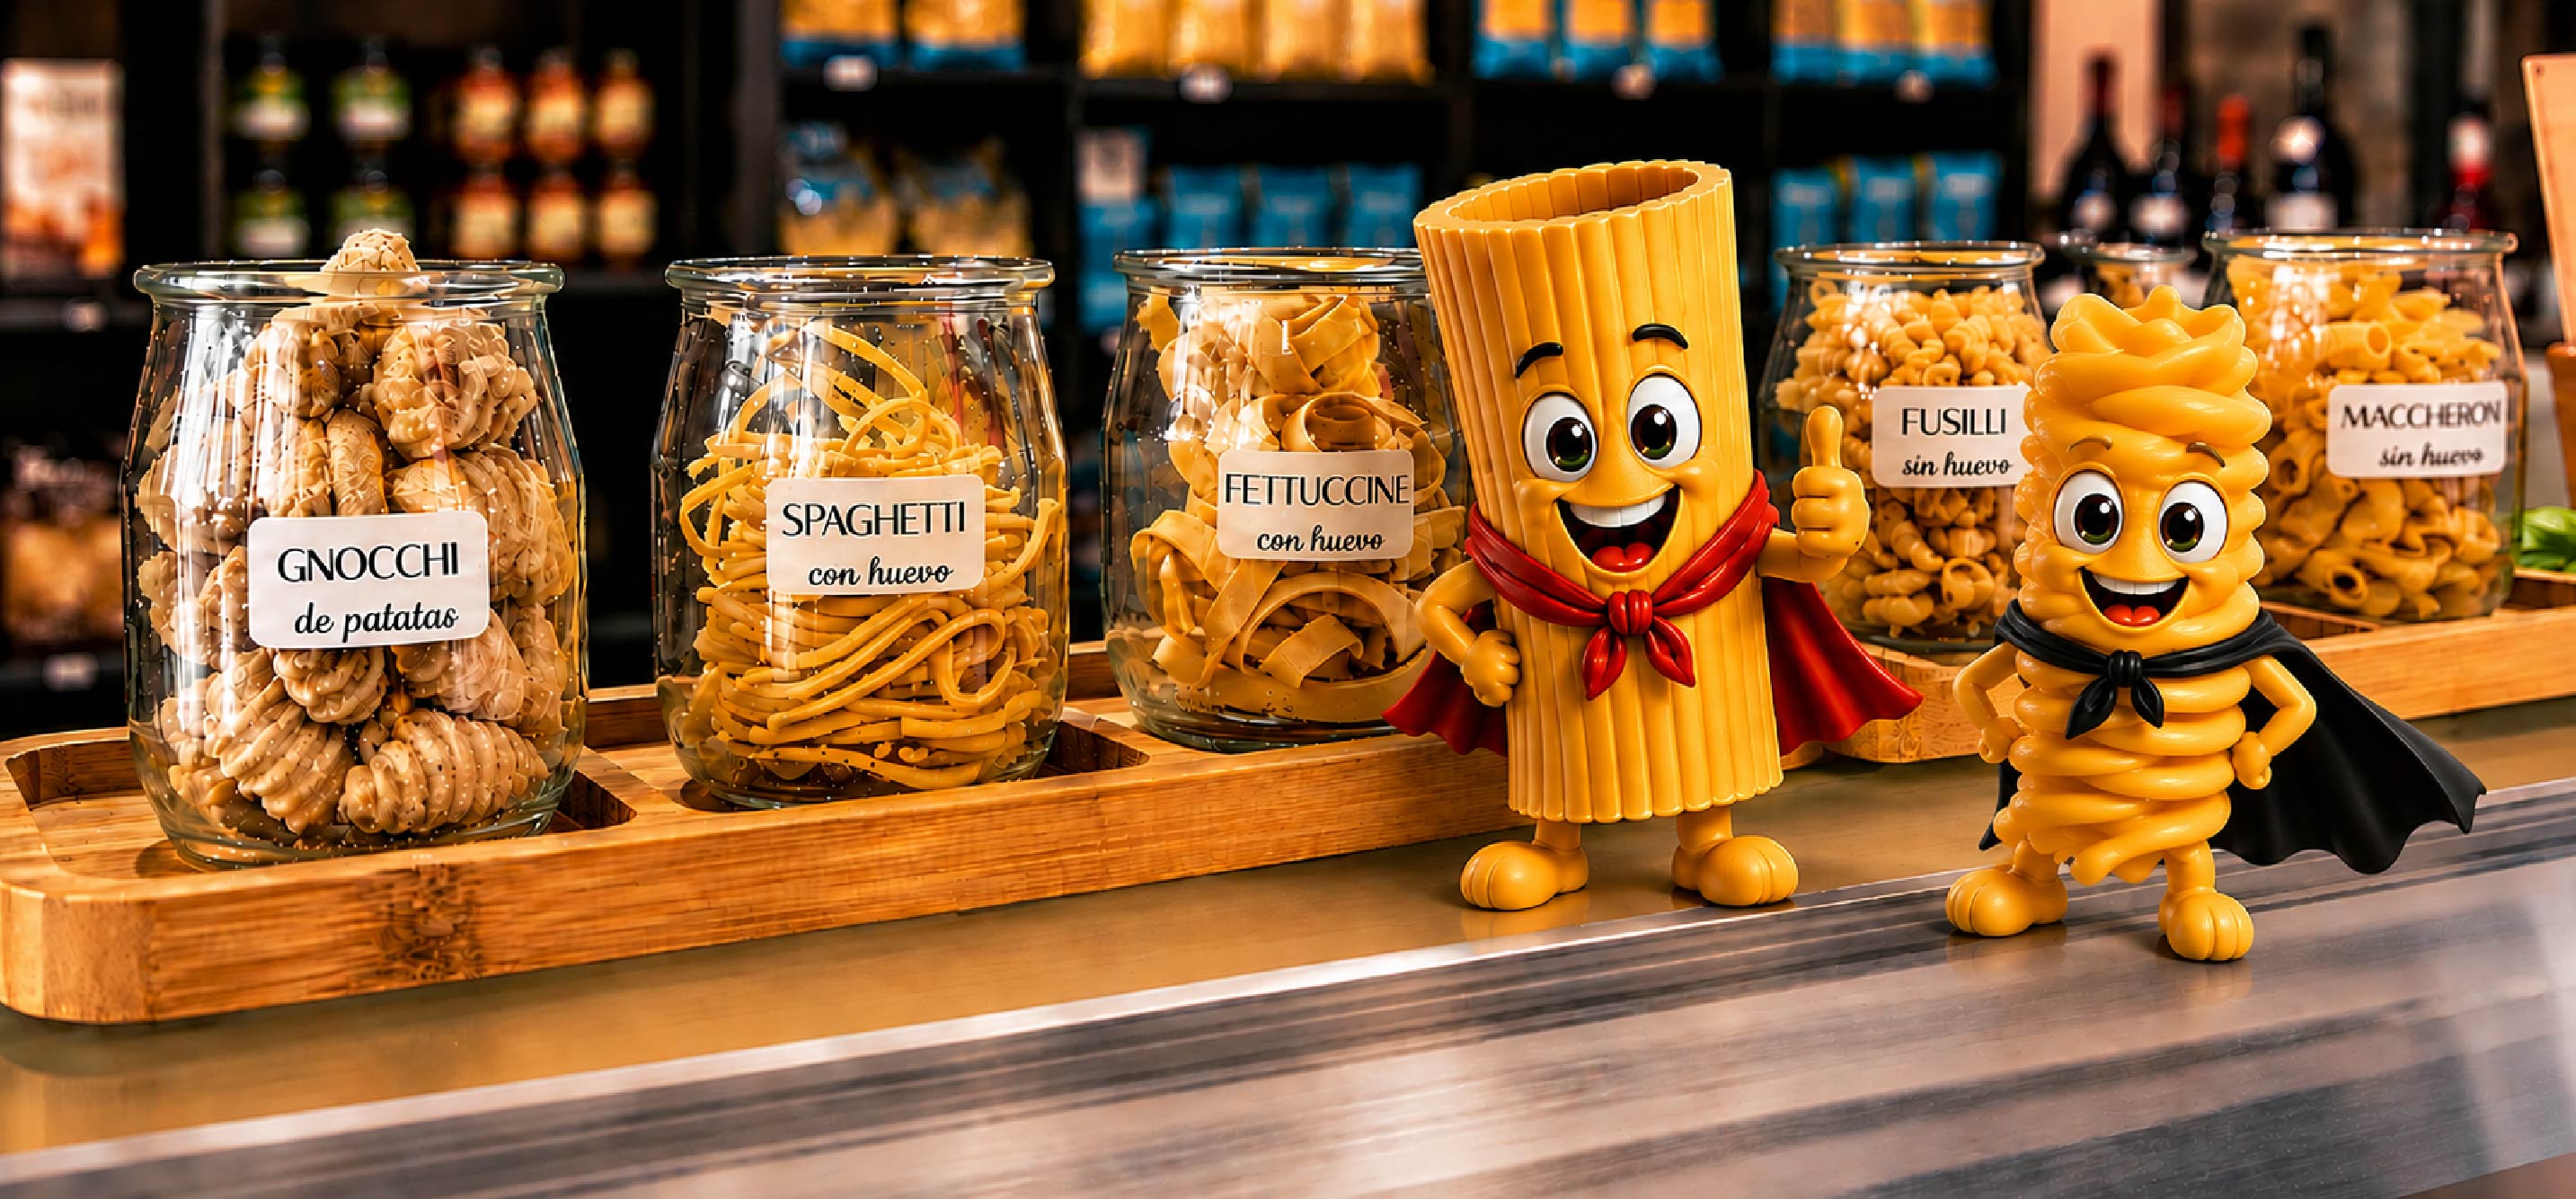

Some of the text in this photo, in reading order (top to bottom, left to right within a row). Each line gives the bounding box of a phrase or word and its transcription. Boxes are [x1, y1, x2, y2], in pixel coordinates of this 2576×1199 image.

[1901, 407, 2006, 436] FUSILLI
[1902, 450, 2013, 476] sin huevo
[2379, 441, 2483, 467] sin huevo
[1225, 474, 1409, 505] FETTUCCINE
[782, 501, 965, 536] SPAGHETTI
[1257, 524, 1385, 552] con huevo
[277, 541, 459, 582] GNOCCHI
[809, 555, 954, 585] con huevo
[295, 601, 459, 643] de patatas
